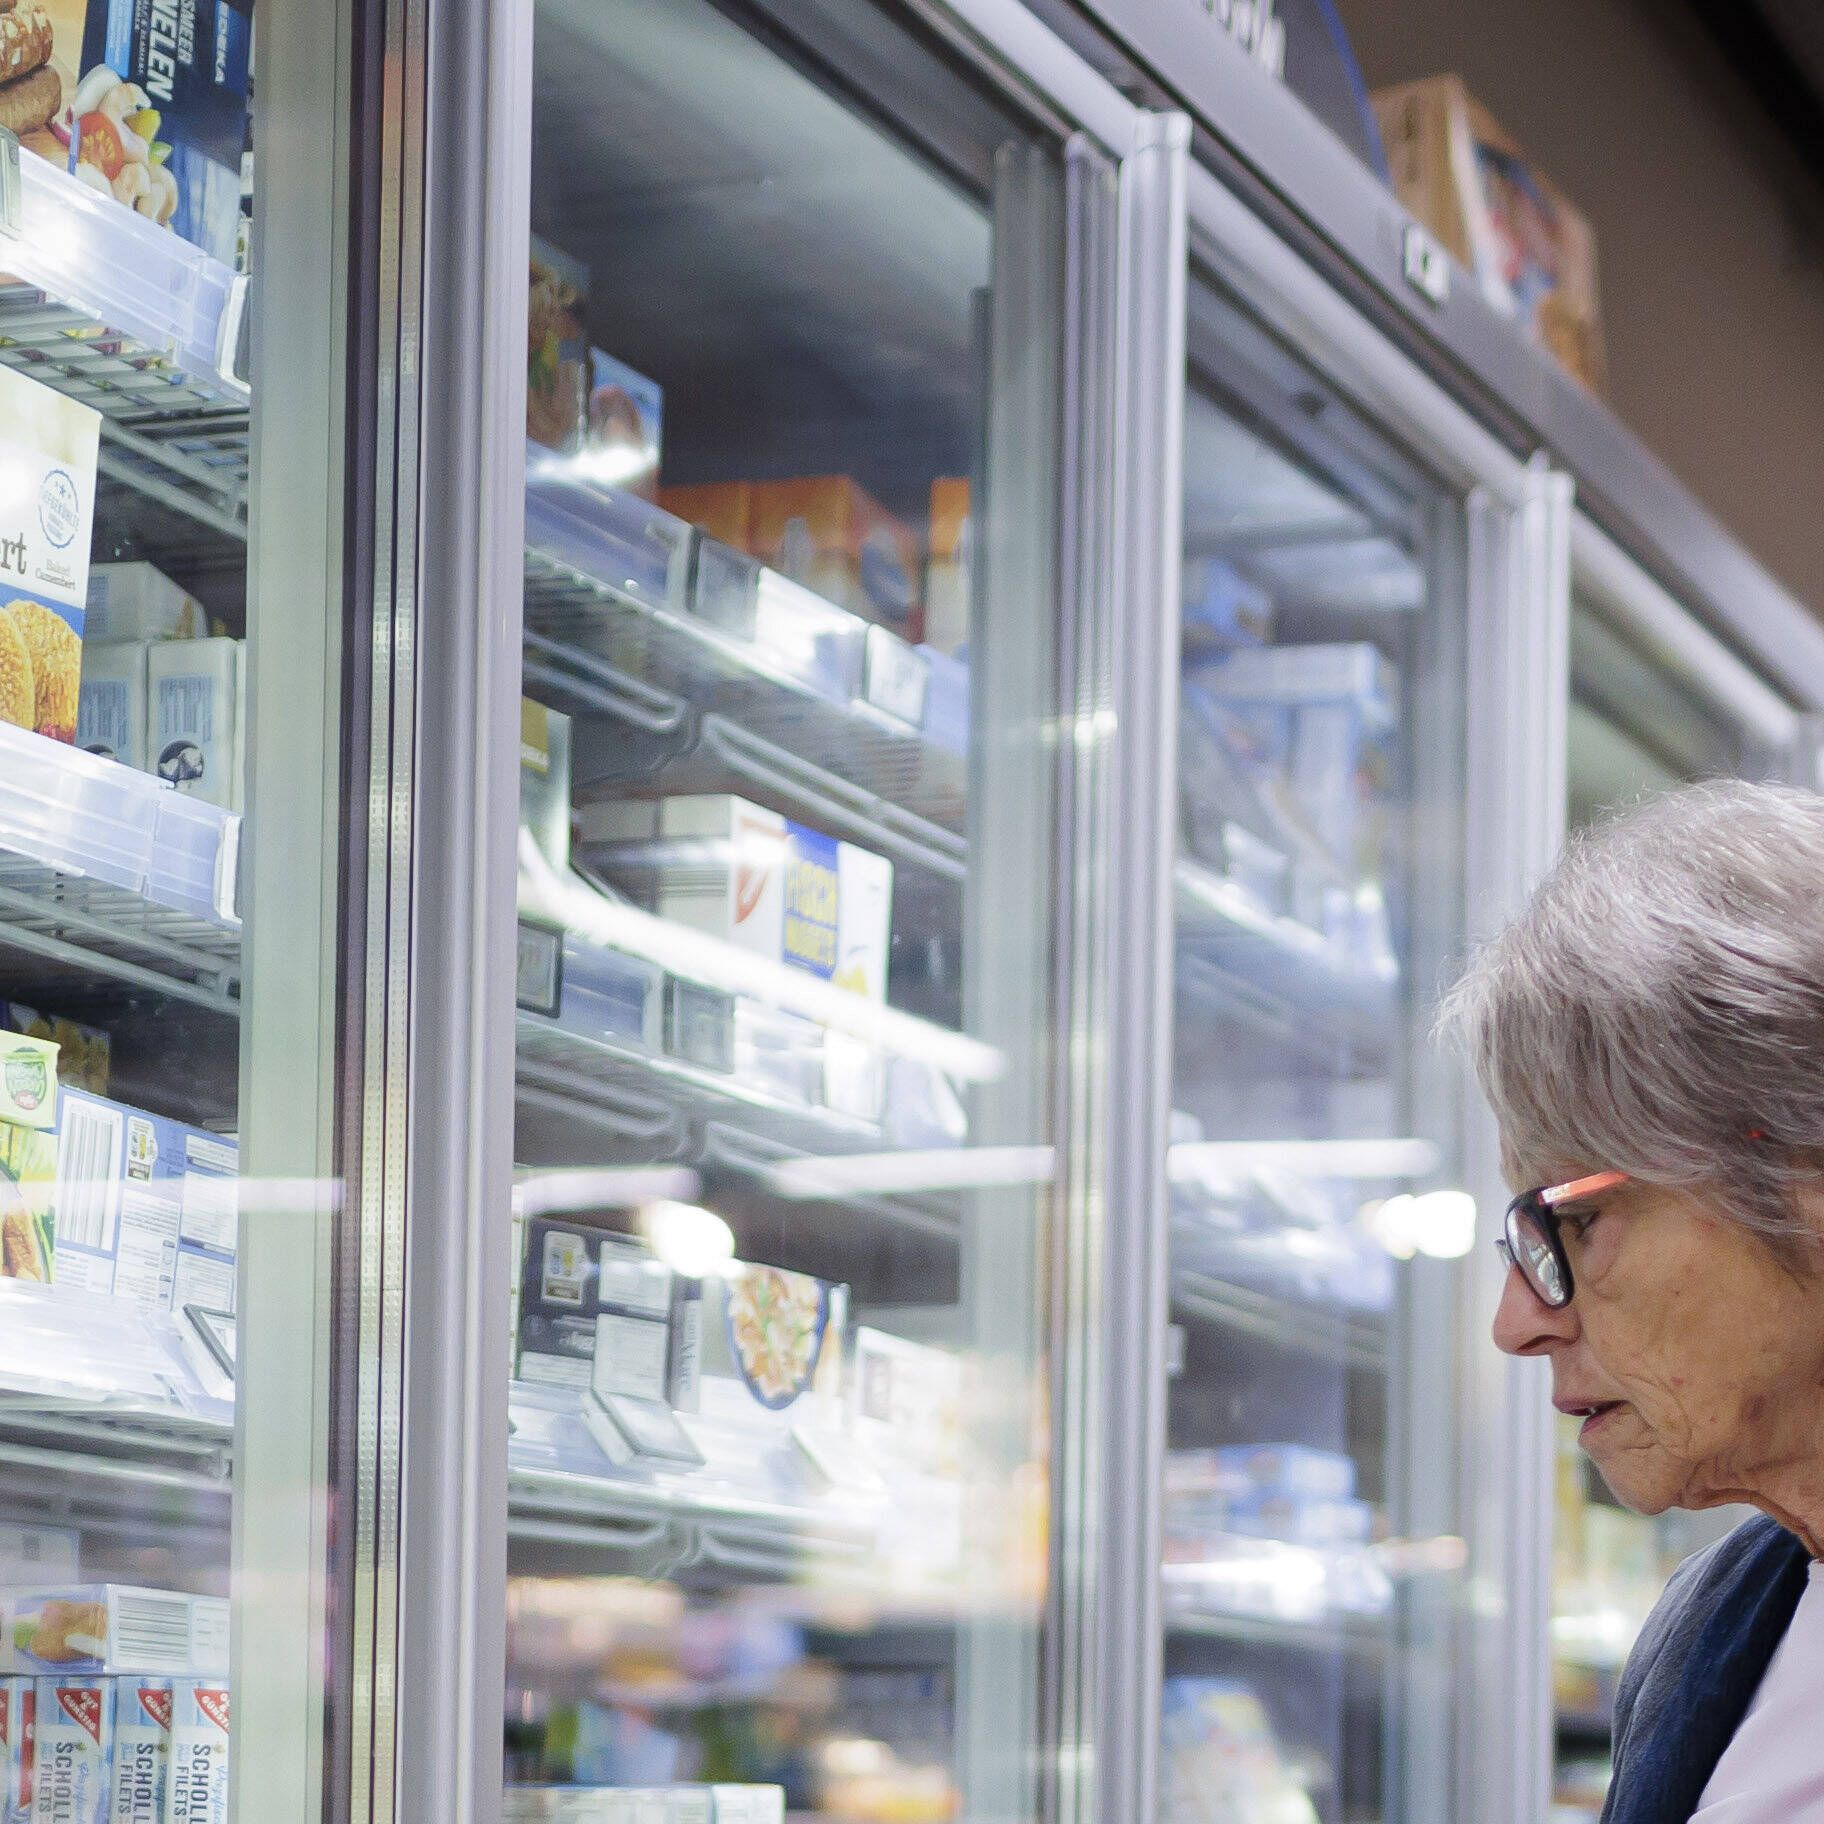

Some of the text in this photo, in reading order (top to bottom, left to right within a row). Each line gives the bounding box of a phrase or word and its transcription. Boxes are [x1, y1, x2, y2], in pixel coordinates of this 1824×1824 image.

[39, 1763, 53, 1813] FILETS
[118, 1765, 133, 1814] FILETS
[173, 1765, 190, 1817] FILETS
